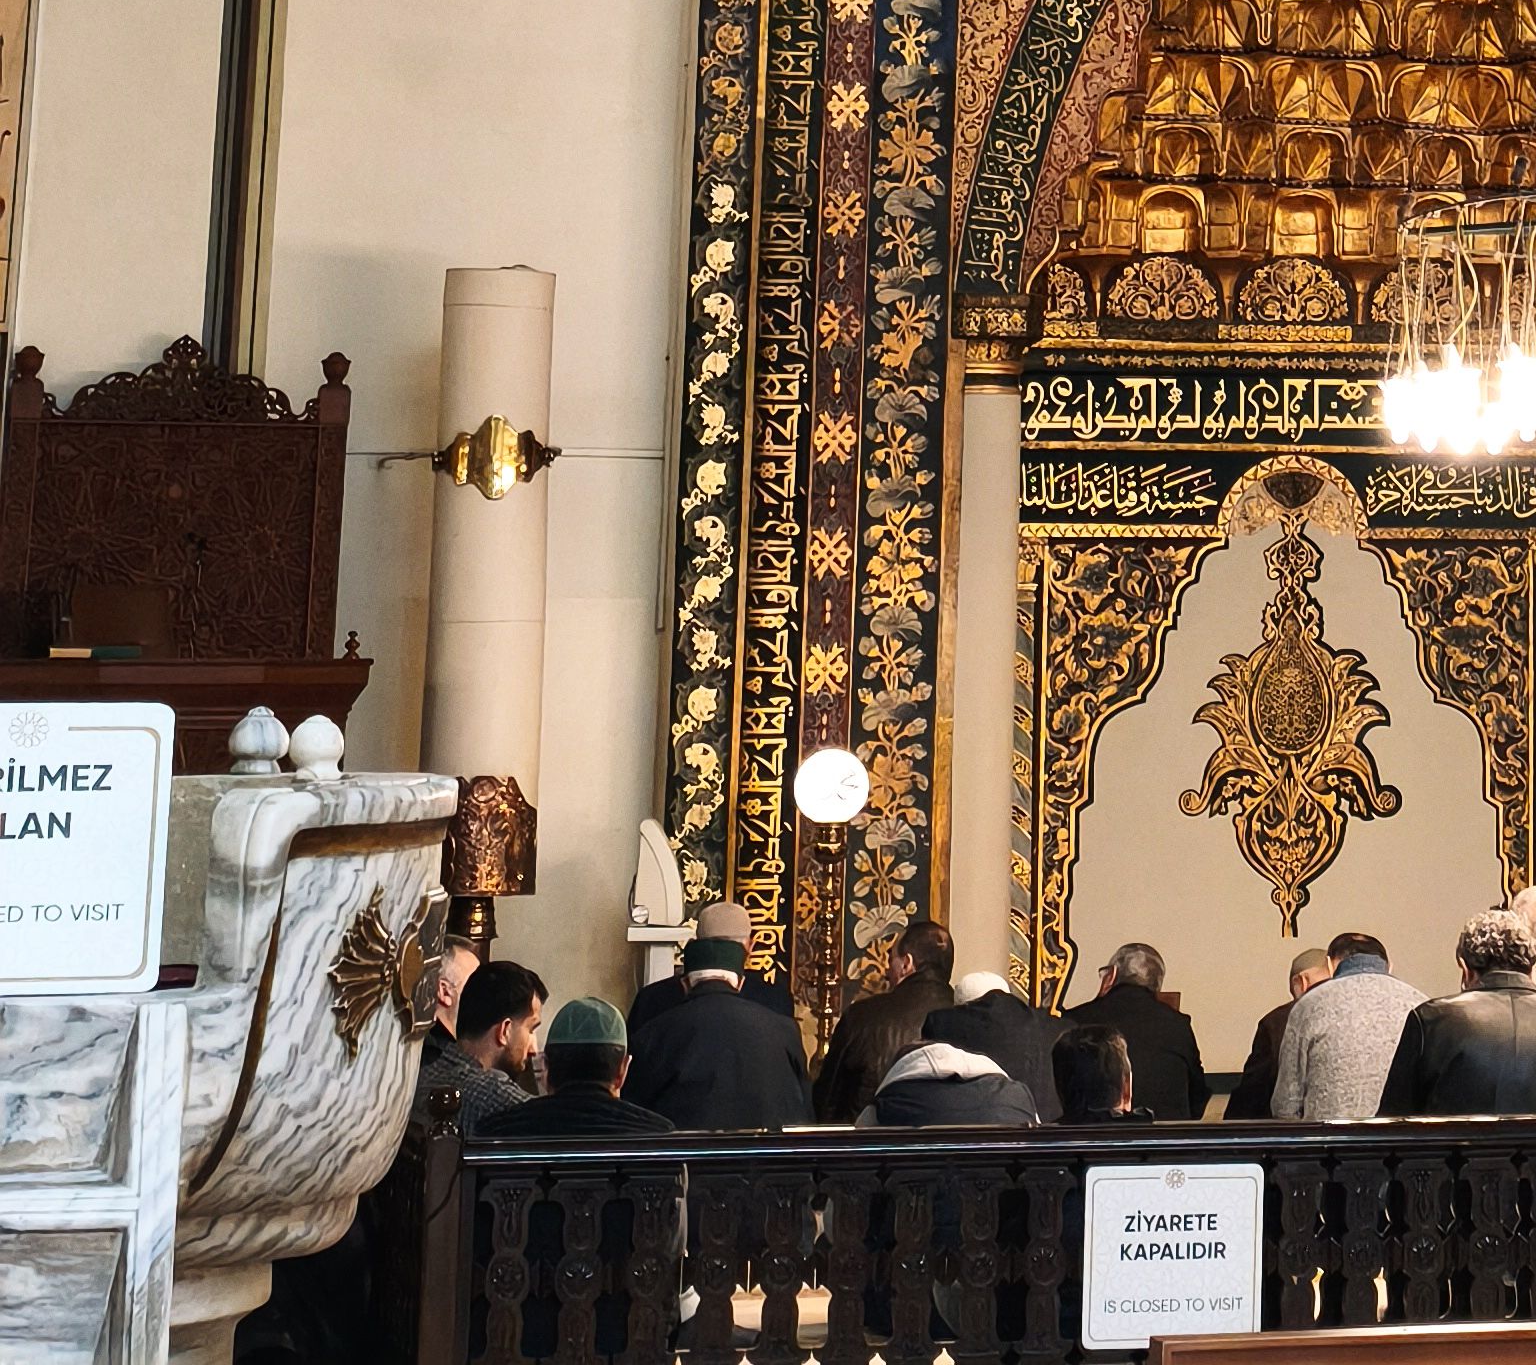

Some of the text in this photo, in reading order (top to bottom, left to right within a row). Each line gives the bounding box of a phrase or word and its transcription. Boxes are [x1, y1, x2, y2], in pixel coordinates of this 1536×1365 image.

[31, 904, 63, 922] TO
[70, 902, 125, 922] VISIT
[1124, 1209, 1218, 1233] ZİYARETE
[1120, 1241, 1226, 1261] KAPALIDIR
[1103, 1299, 1117, 1314] IS
[1120, 1297, 1181, 1314] CLOSED
[1185, 1297, 1206, 1312] TO
